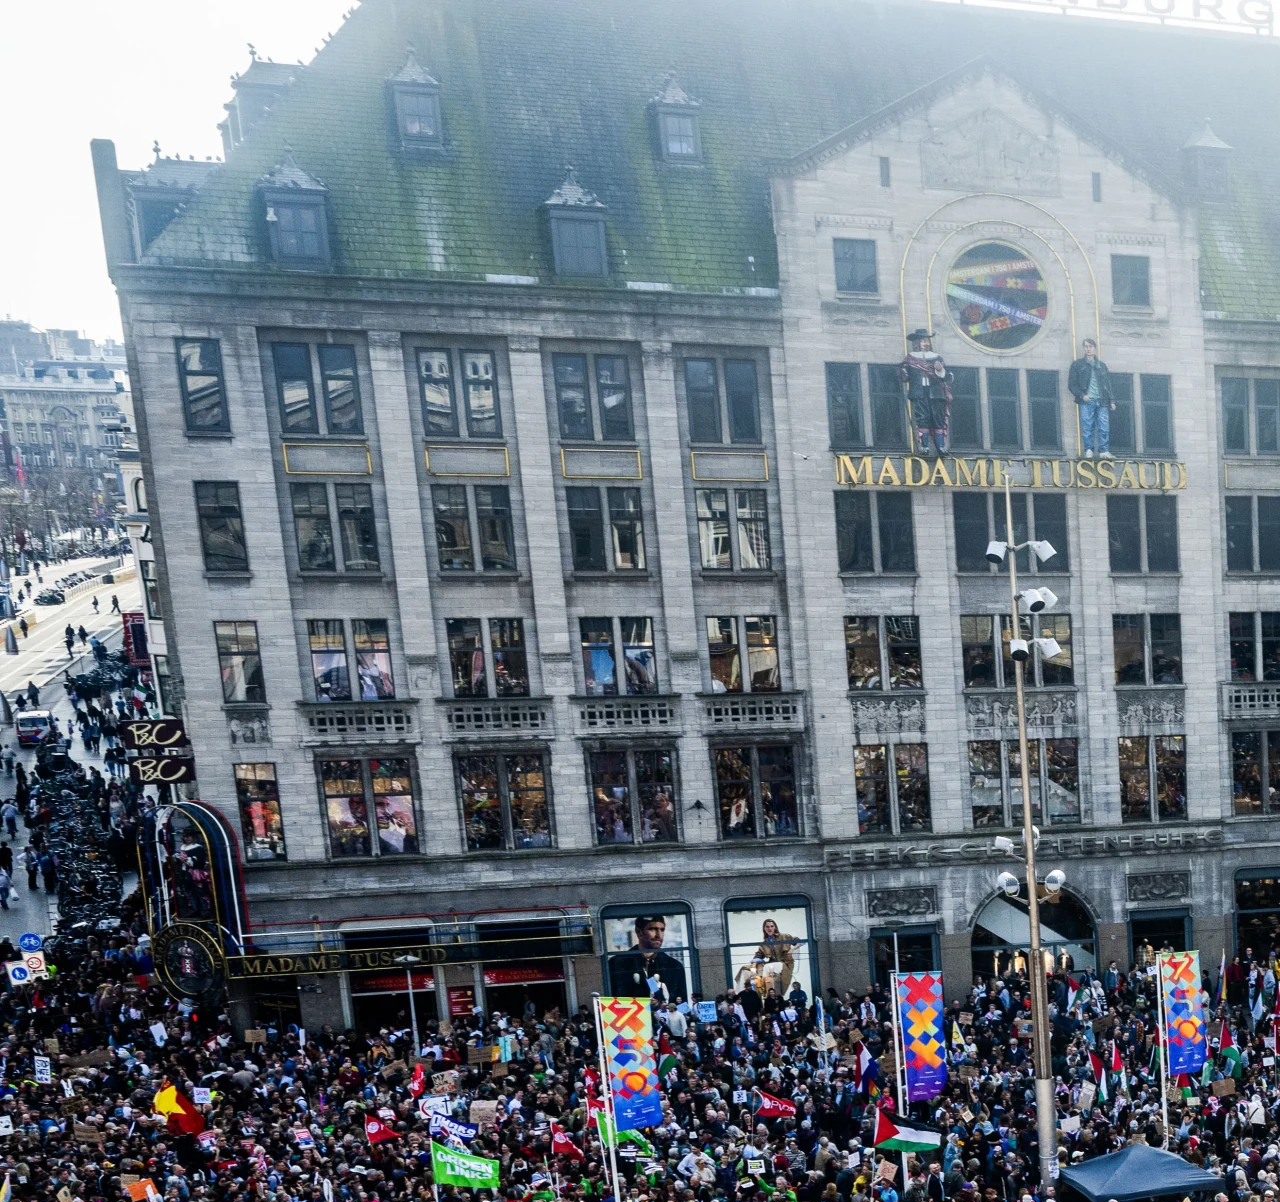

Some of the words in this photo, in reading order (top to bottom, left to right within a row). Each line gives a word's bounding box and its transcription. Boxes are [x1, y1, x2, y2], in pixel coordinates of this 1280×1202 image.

[836, 455, 1013, 487] MADAME
[1023, 459, 1187, 490] TUSSAUD
[127, 723, 181, 746] P&C
[133, 759, 187, 782] P&C
[824, 846, 917, 863] PEEK
[243, 954, 343, 974] MADAME
[436, 1148, 493, 1175] GROEN
[445, 1161, 493, 1180] LINKS
